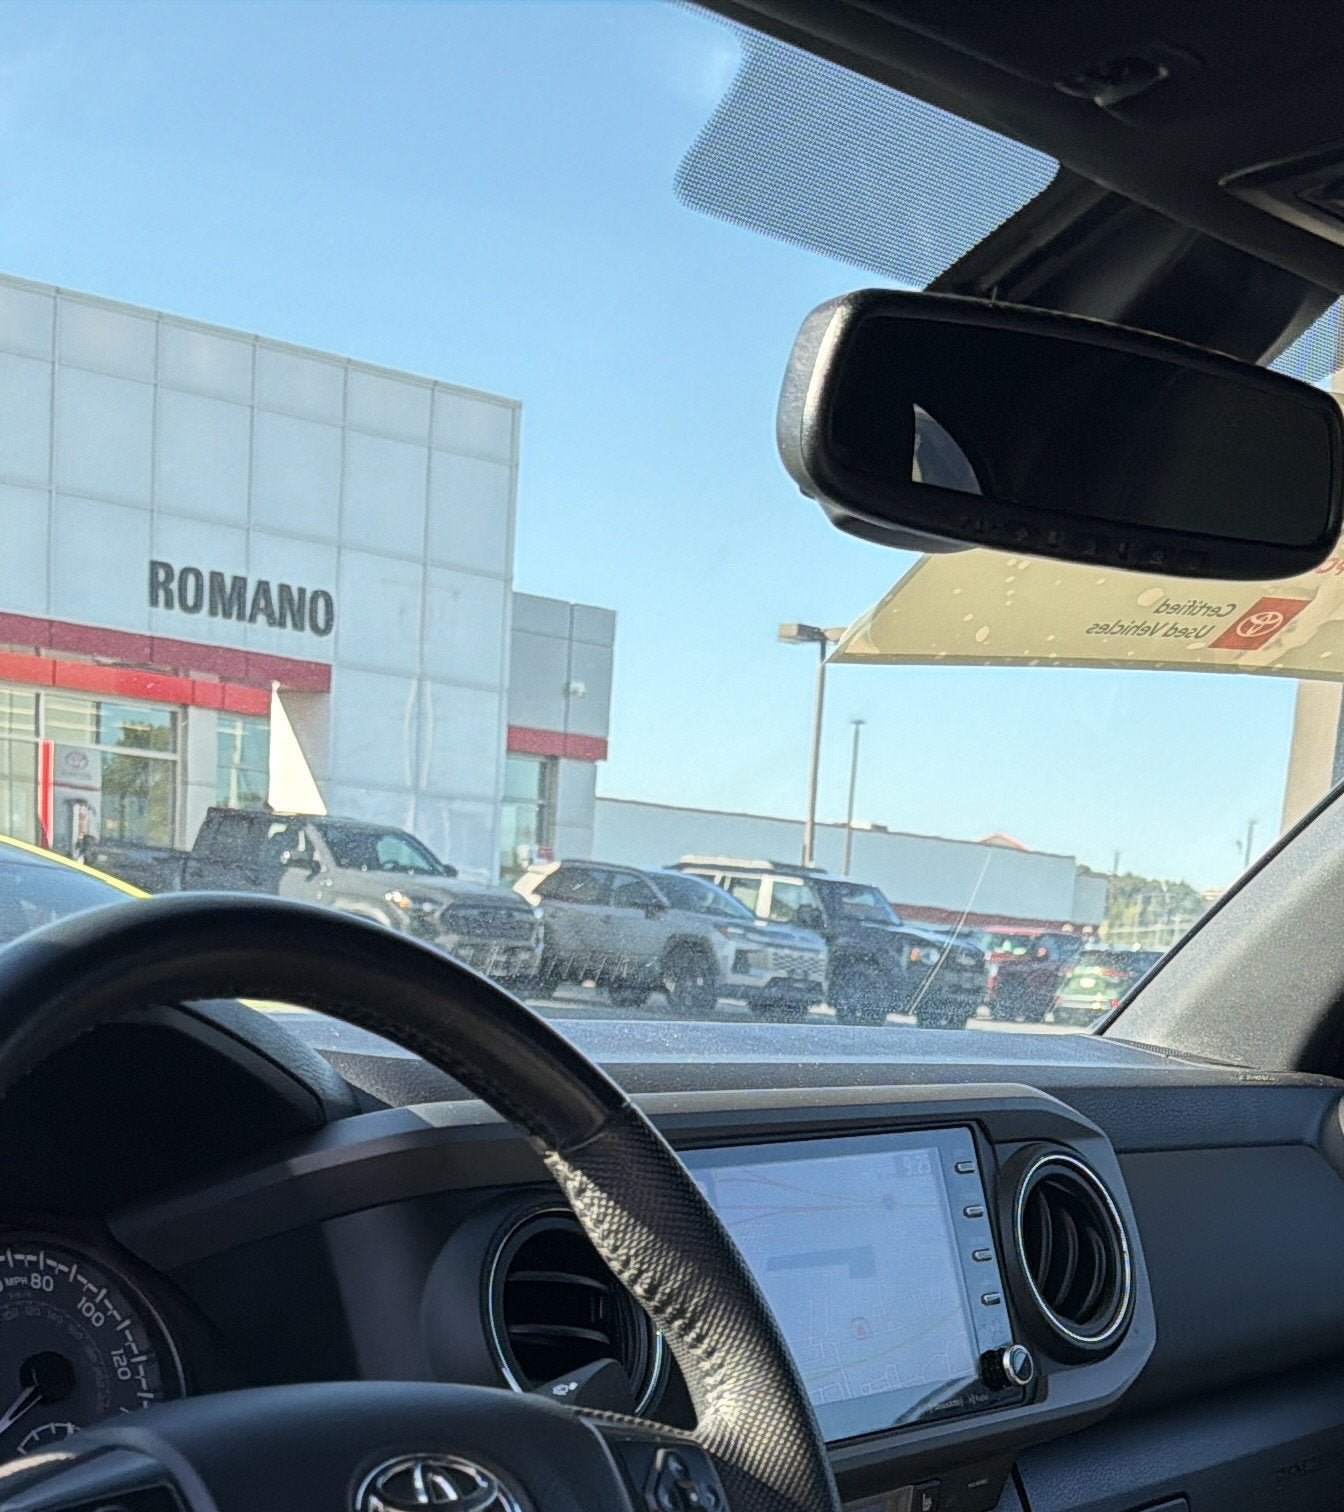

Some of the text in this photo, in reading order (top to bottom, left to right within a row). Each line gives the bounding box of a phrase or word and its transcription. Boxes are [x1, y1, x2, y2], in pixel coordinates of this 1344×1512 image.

[149, 559, 336, 636] ROMANO
[4, 1276, 28, 1287] MPH
[30, 1272, 54, 1292] 80
[76, 1296, 105, 1327] 100
[110, 1349, 132, 1381] 120
